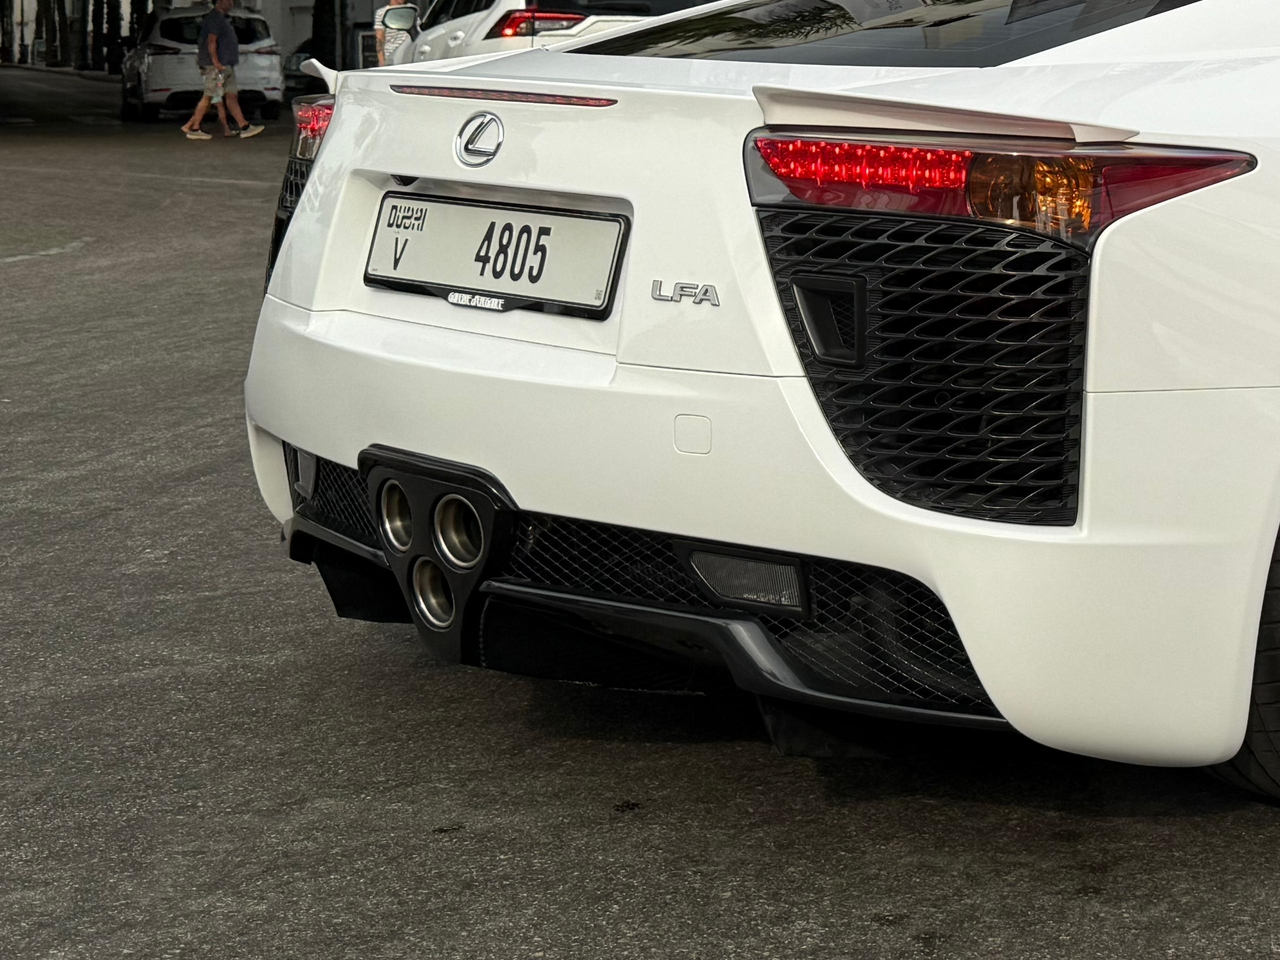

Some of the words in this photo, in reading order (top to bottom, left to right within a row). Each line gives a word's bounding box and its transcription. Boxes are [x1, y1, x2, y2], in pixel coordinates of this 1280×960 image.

[393, 237, 409, 271] V
[474, 221, 552, 284] 4805
[651, 279, 721, 306] LFA
